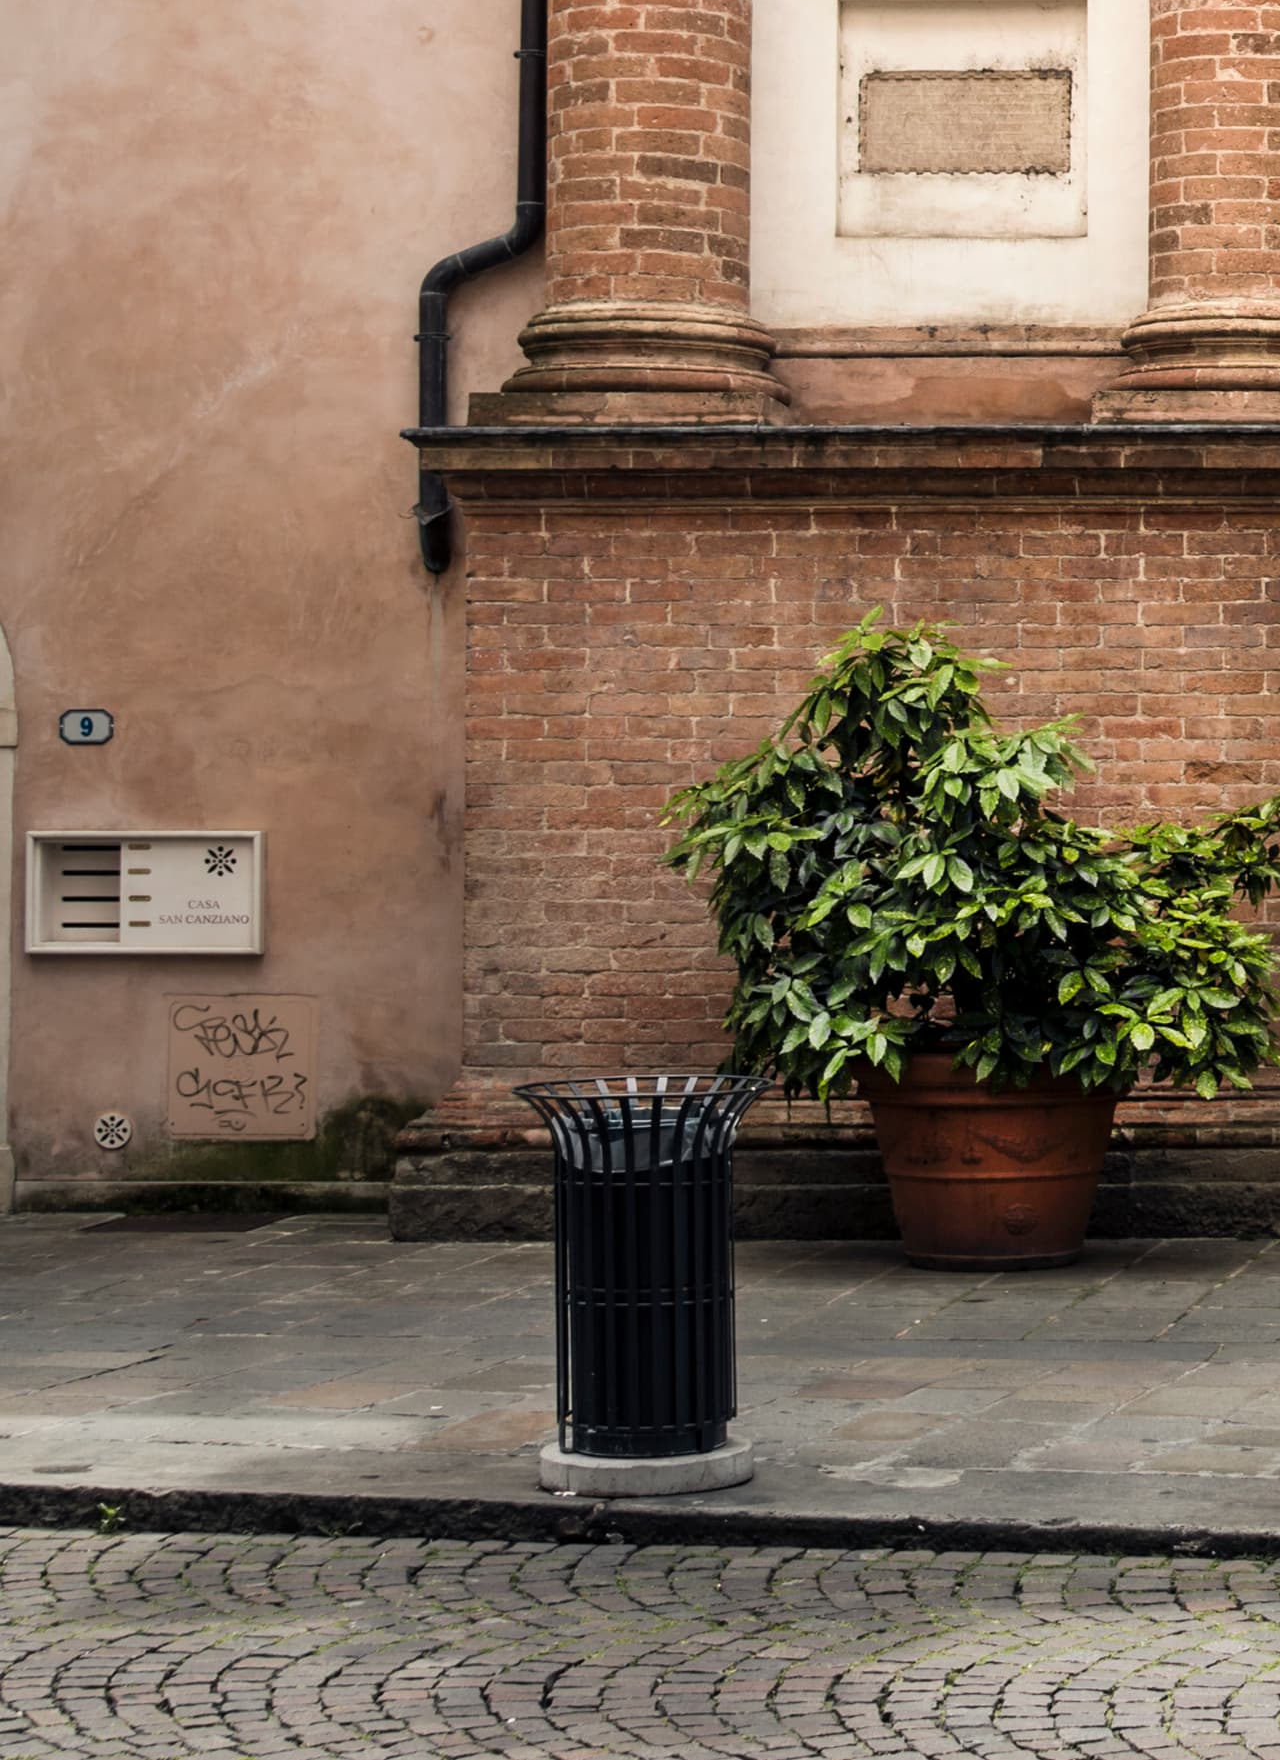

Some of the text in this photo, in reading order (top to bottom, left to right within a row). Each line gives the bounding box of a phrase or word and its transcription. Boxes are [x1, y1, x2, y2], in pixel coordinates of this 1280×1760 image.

[79, 716, 94, 737] 9
[188, 899, 221, 909] CASA
[159, 914, 250, 924] SAN CANZIANO
